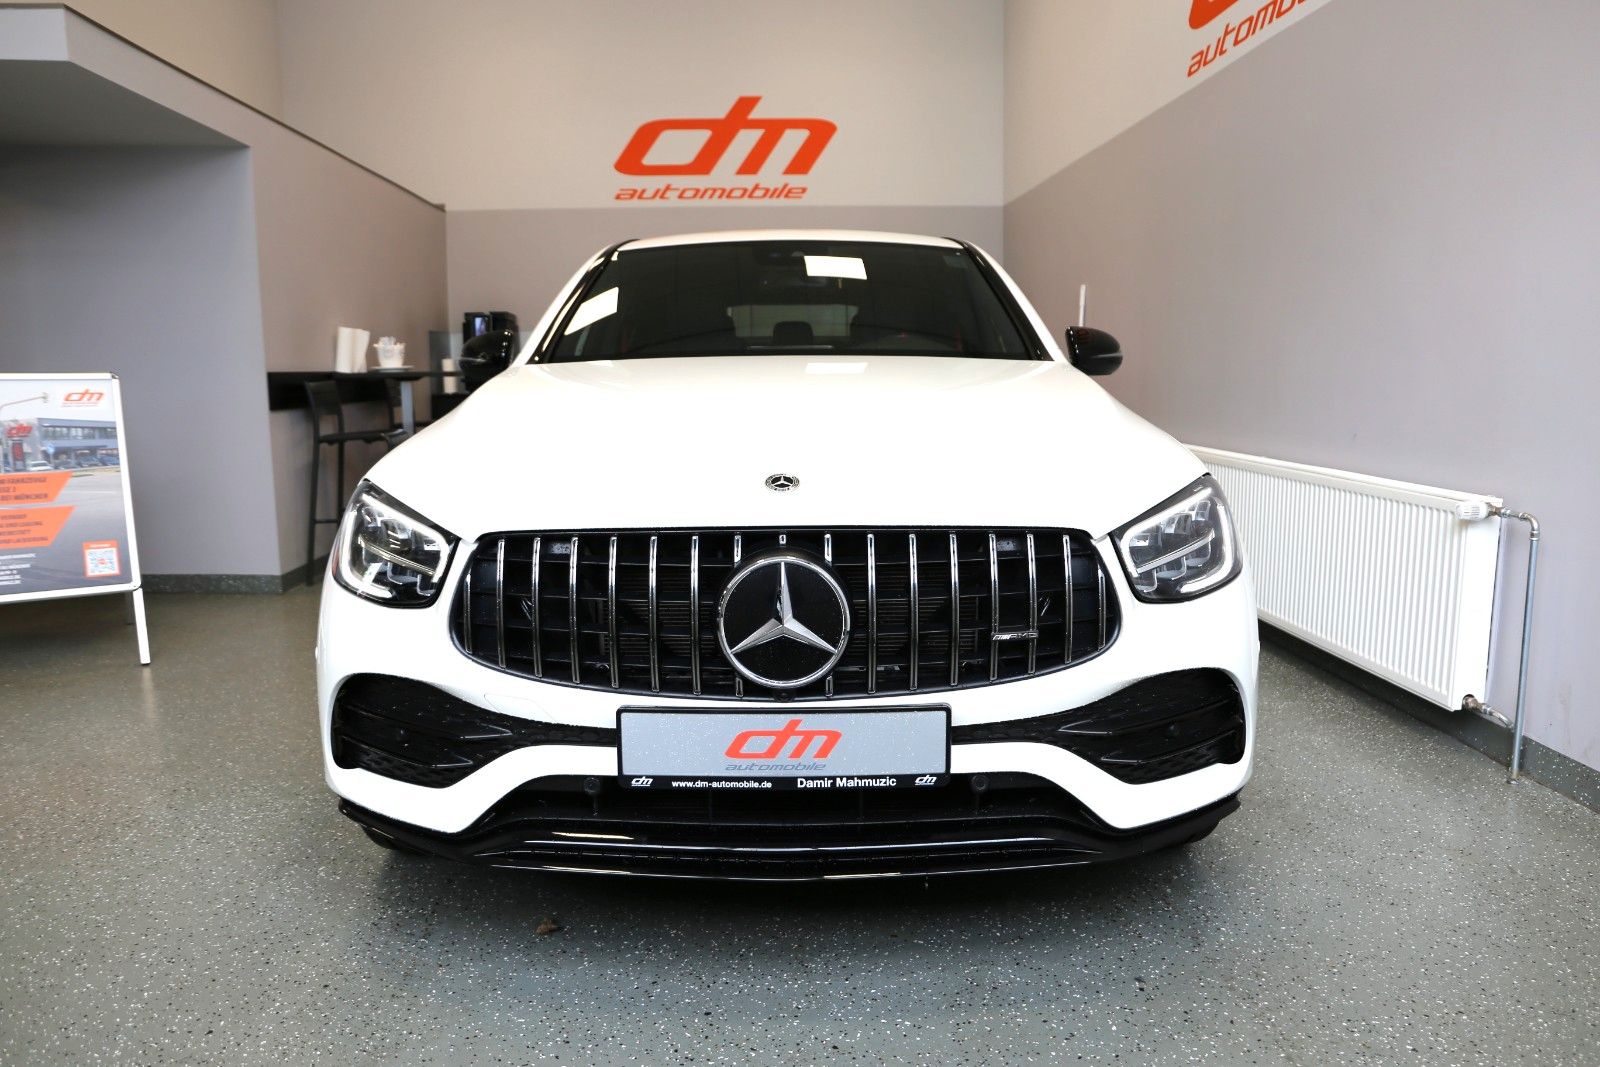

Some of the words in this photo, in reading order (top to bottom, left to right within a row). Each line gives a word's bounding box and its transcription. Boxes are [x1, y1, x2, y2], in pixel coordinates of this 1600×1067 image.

[1187, 0, 1306, 77] automo
[613, 95, 838, 176] dm
[615, 183, 808, 201] automobile
[724, 718, 842, 760] dm
[631, 776, 653, 785] dm
[671, 779, 772, 789] www.dm-automobile.de
[797, 777, 833, 788] Damir
[836, 776, 897, 788] Mahmuzic
[914, 774, 937, 784] dm
[725, 762, 827, 771] automobile
